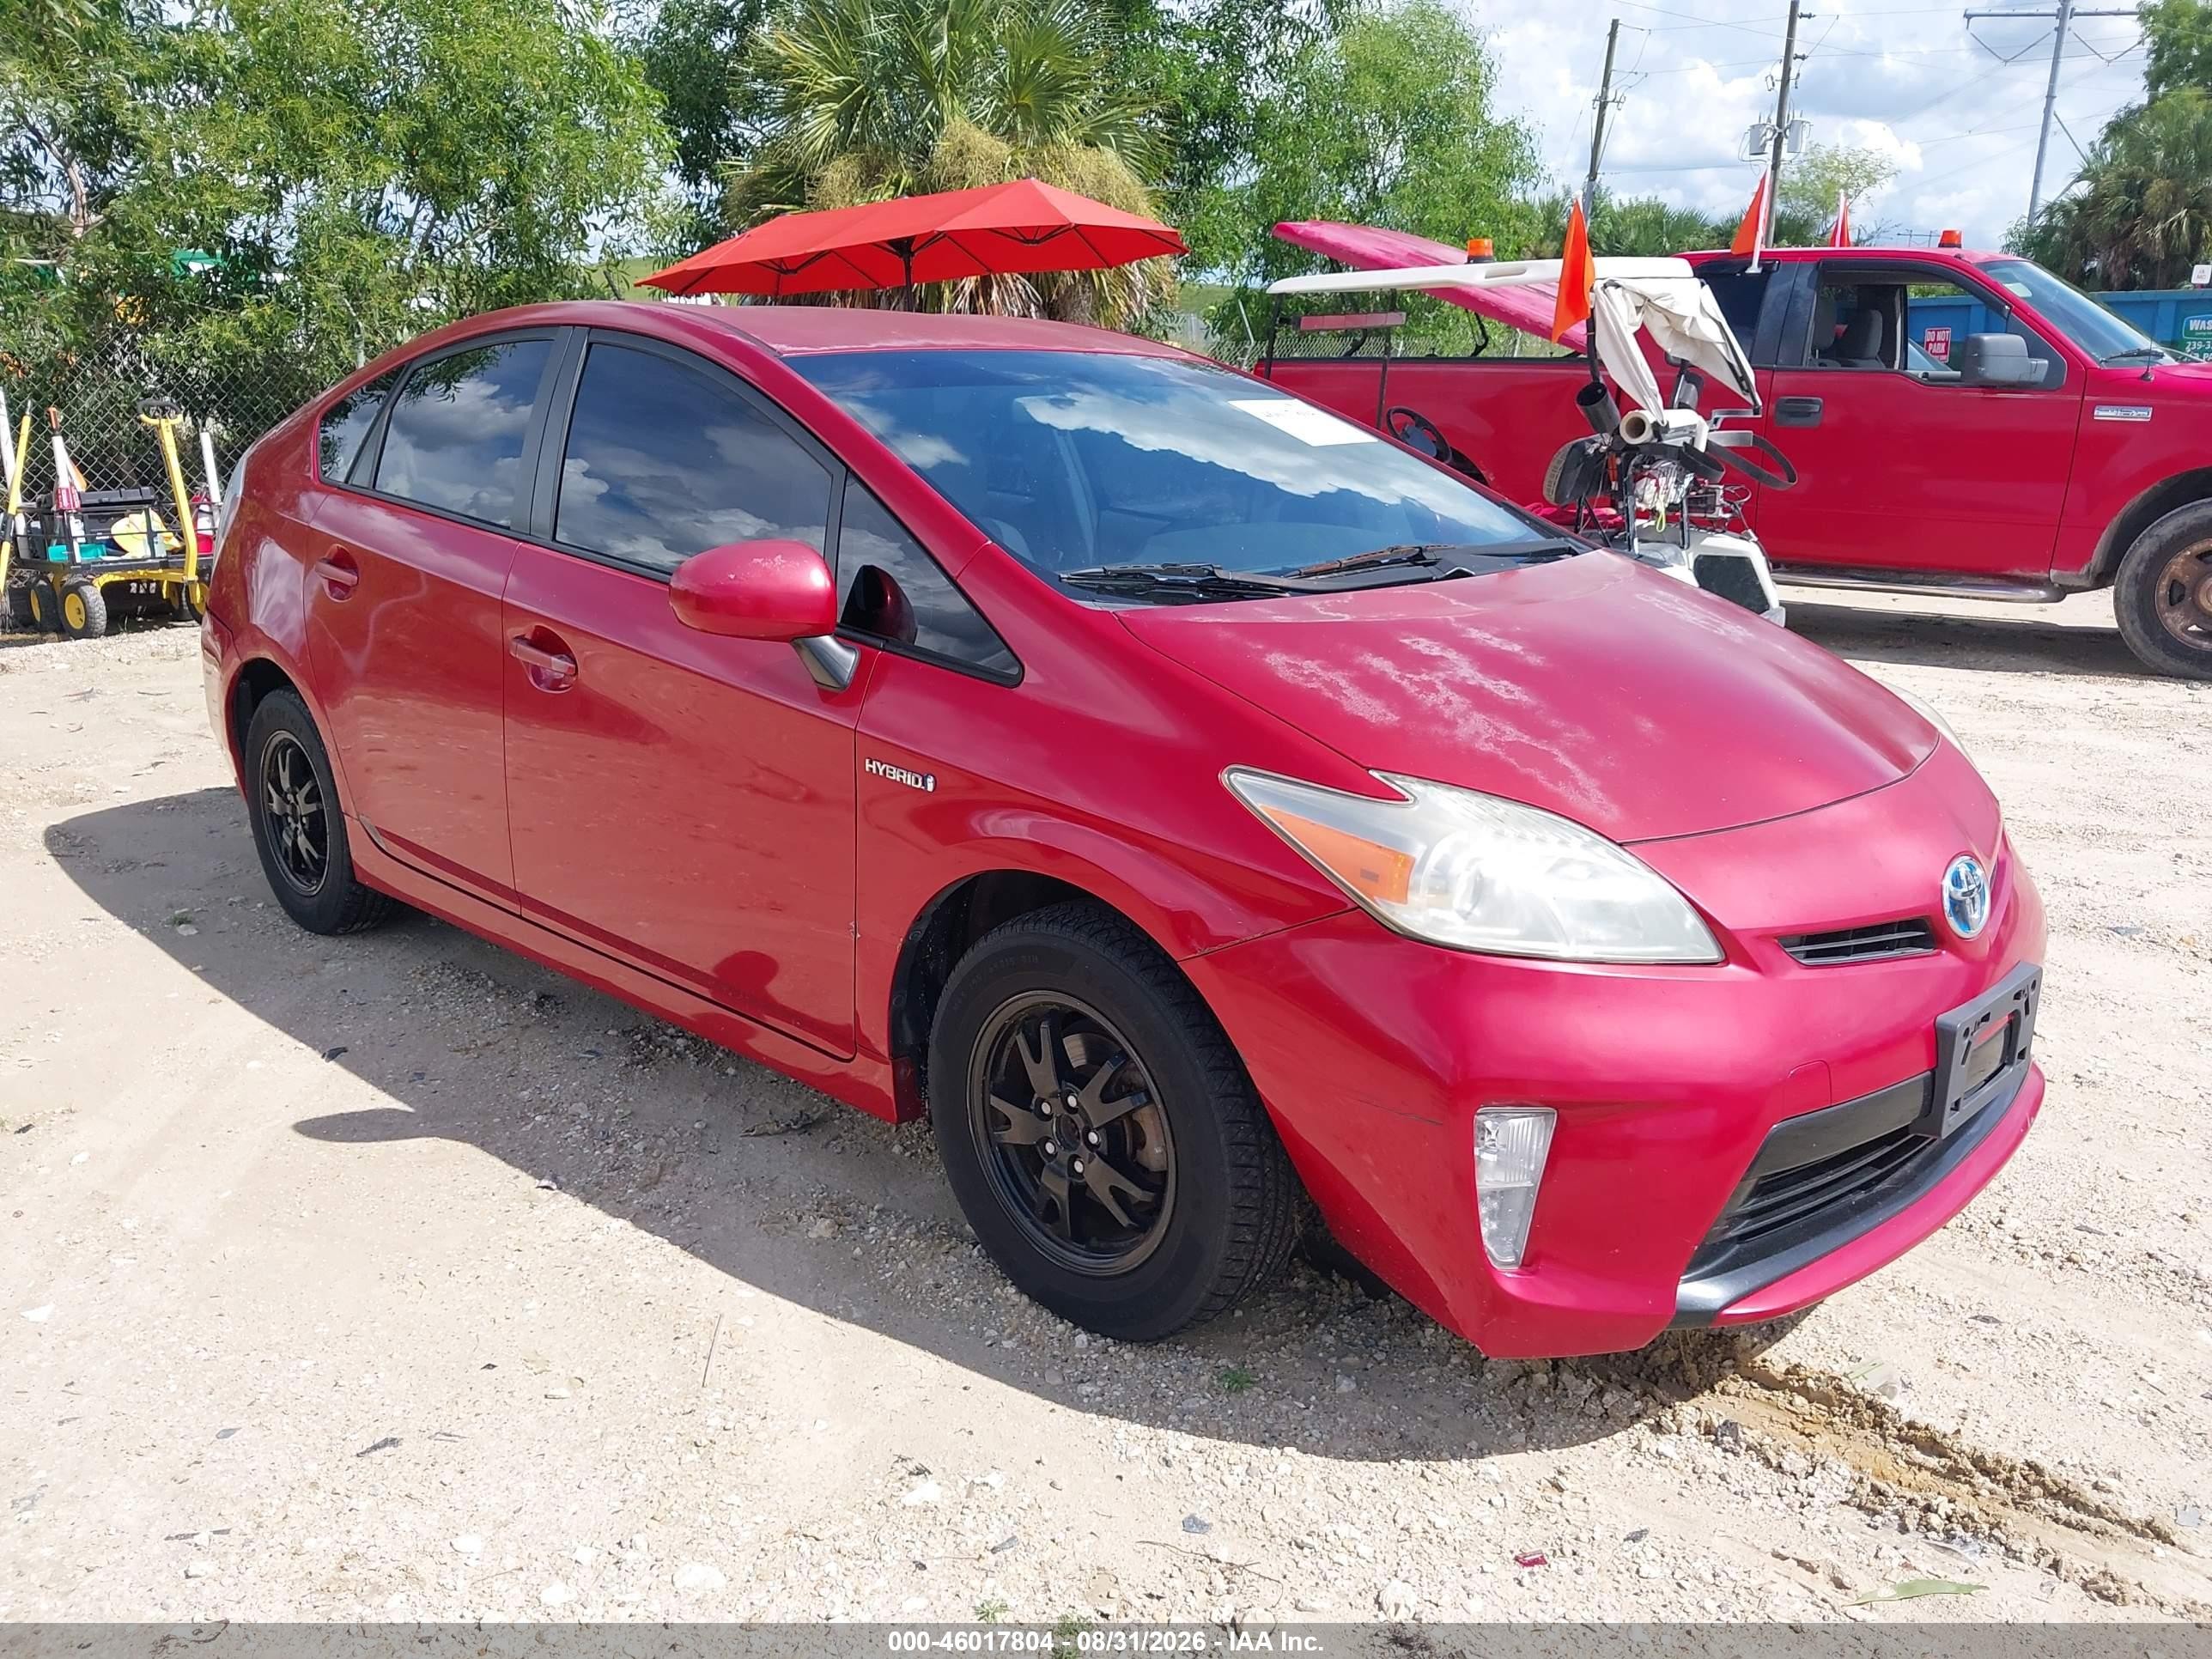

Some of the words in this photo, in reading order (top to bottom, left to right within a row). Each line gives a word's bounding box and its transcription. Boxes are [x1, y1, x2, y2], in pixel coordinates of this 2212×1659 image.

[1927, 330, 1936, 342] DO
[1936, 330, 1949, 342] NOT
[1928, 343, 1946, 354] PARK
[865, 758, 923, 789] HYBRID
